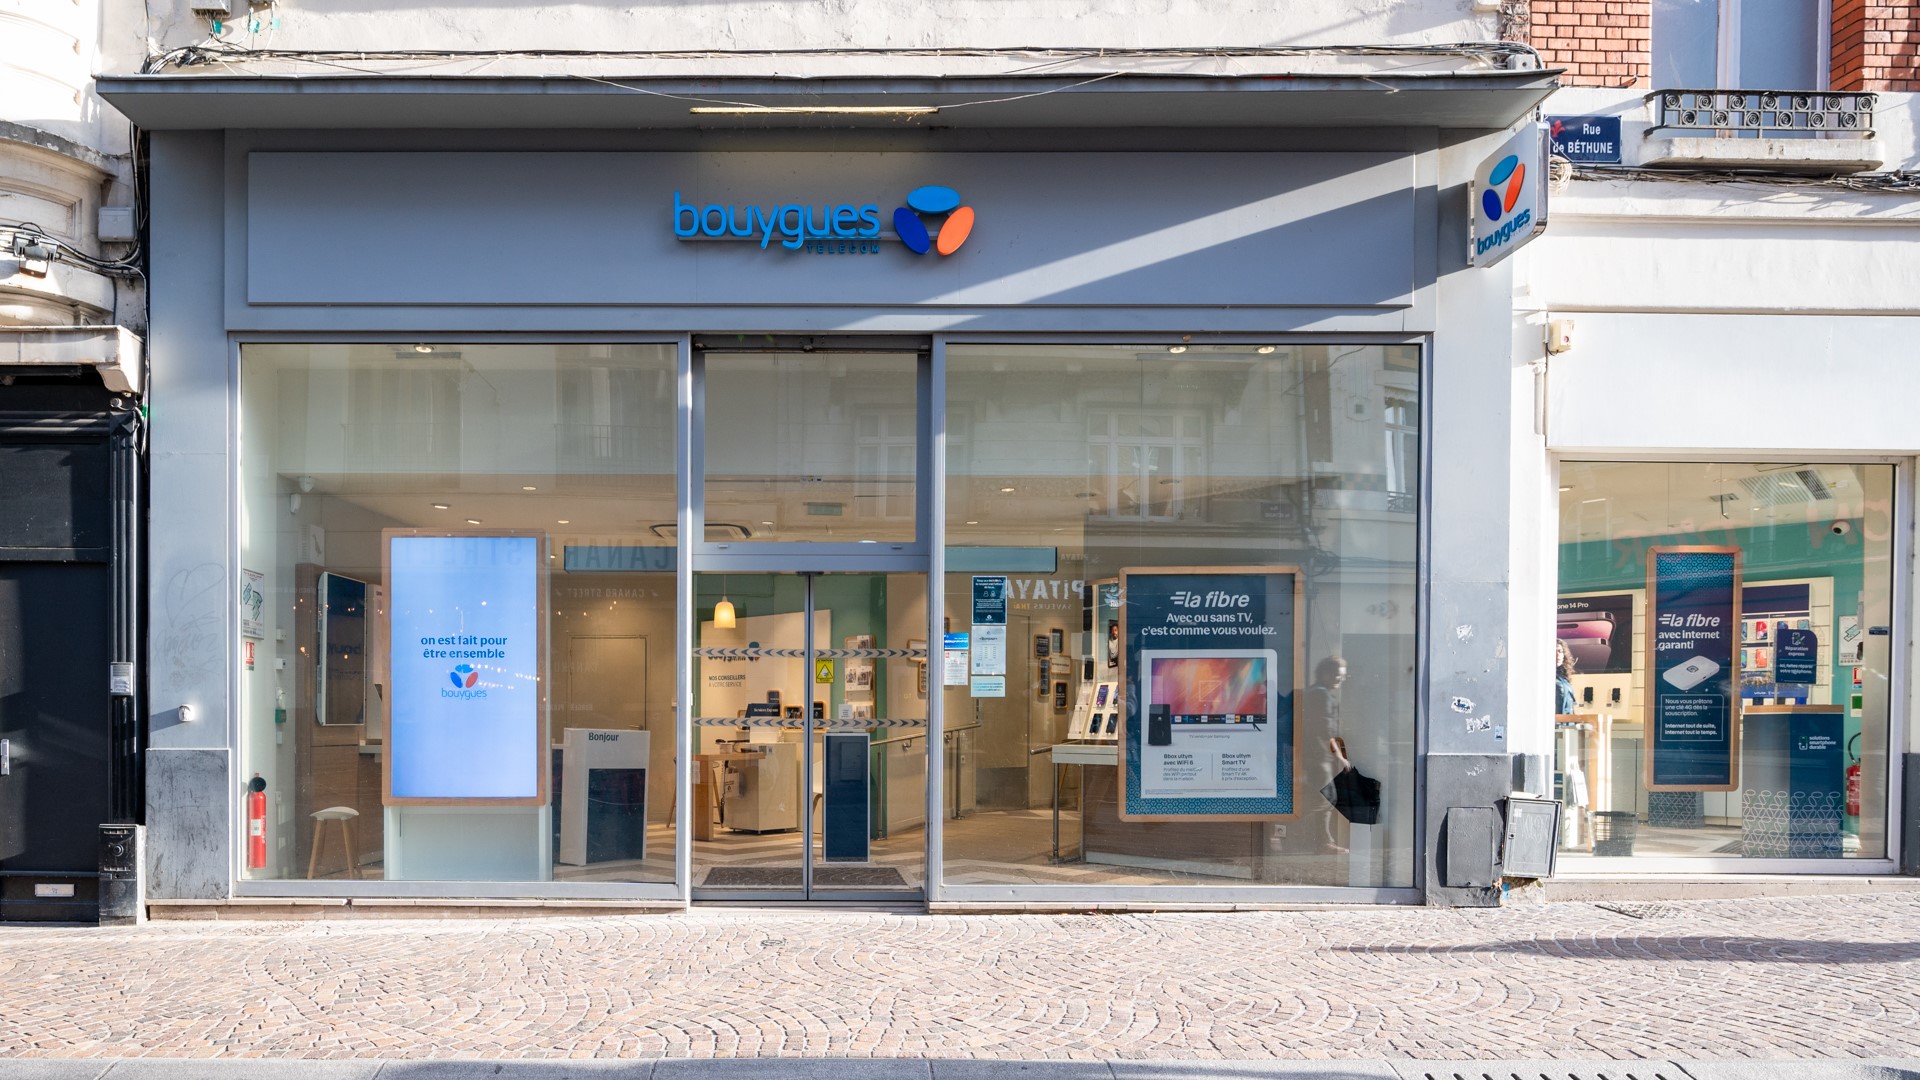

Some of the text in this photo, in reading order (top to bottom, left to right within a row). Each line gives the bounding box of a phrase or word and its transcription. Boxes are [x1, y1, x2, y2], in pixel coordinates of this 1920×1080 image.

[1583, 123, 1601, 135] Rue
[1553, 139, 1613, 154] de BÉTHUNE
[674, 191, 881, 250] bouygues
[1477, 208, 1531, 256] bouygues
[806, 243, 880, 254] TELECOM
[1184, 591, 1250, 608] la fibre
[1166, 612, 1253, 624] Avec ou sans TV,
[1670, 613, 1720, 627] la fibre
[1141, 624, 1277, 636] c'est comme vous voulez.
[1659, 629, 1720, 639] avec internet
[421, 634, 508, 648] on est fait pour
[1658, 640, 1694, 651] garanti
[423, 648, 505, 659] être ensemble
[441, 687, 488, 700] bouygues
[588, 732, 619, 742] Bonjour
